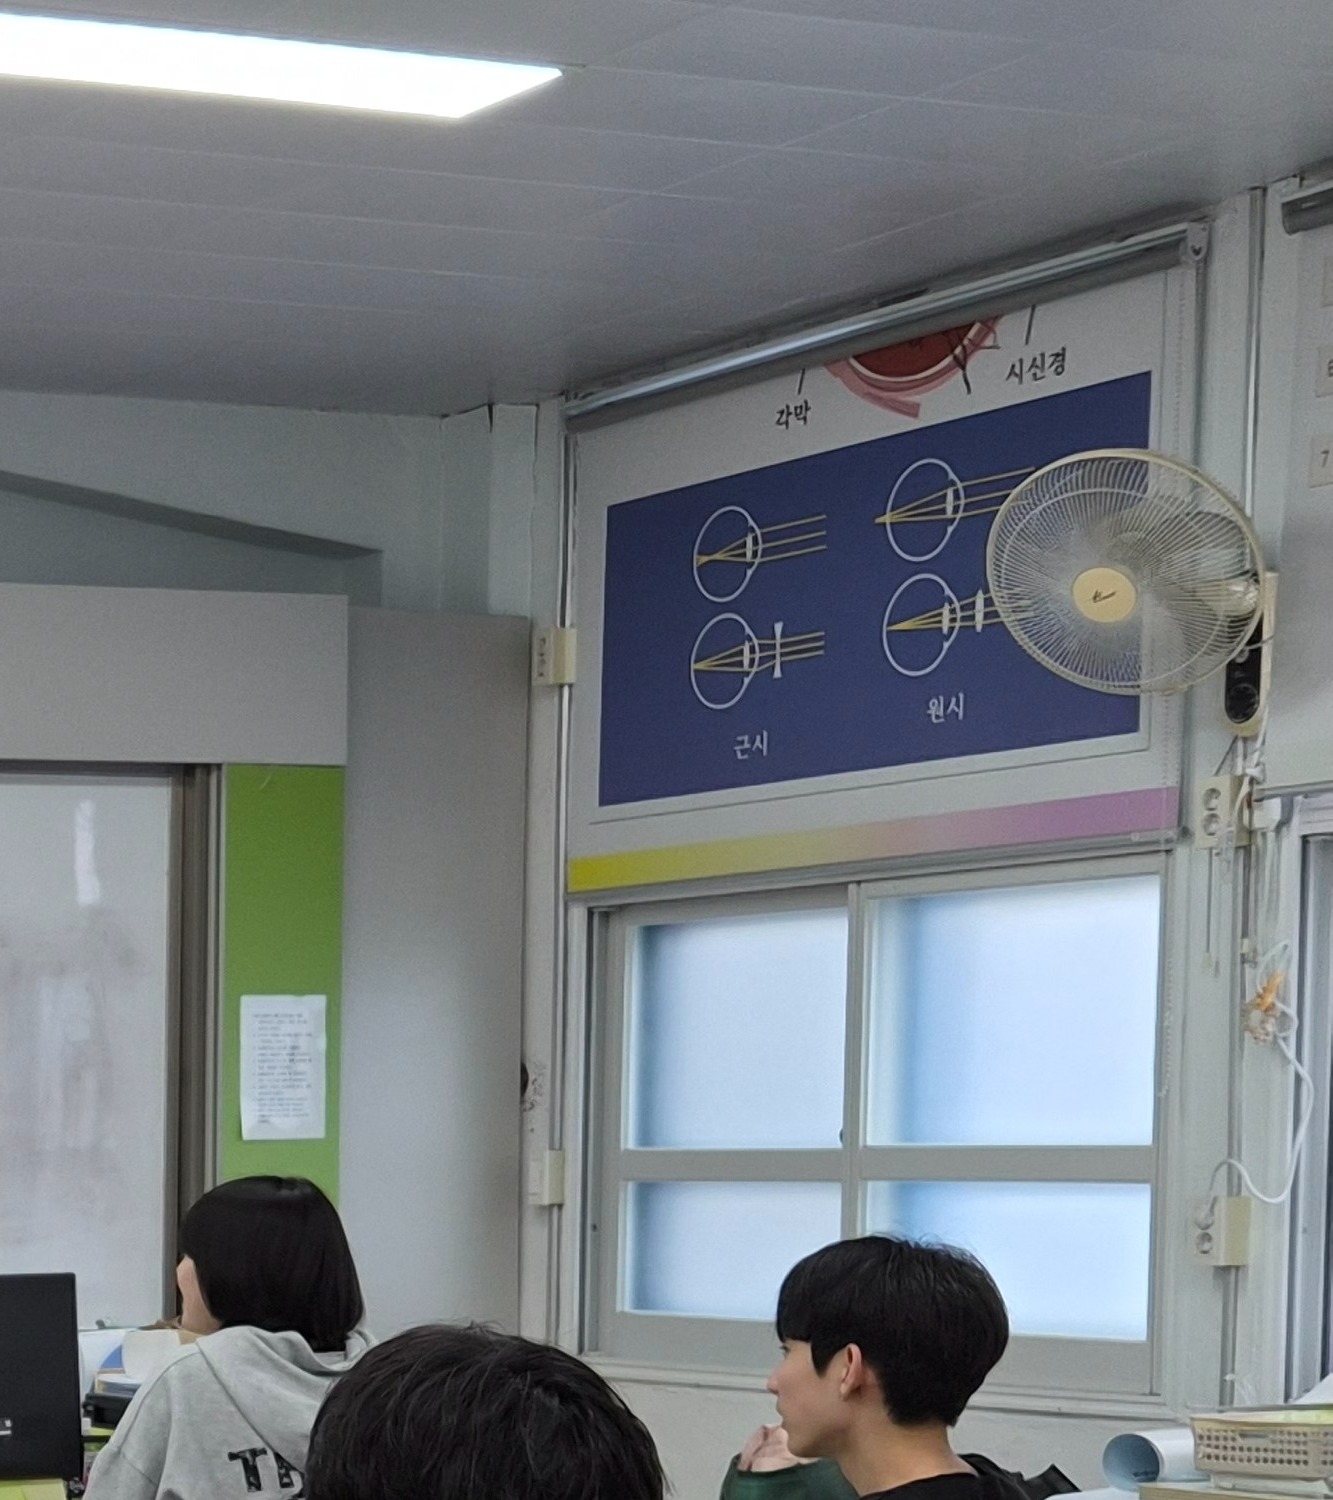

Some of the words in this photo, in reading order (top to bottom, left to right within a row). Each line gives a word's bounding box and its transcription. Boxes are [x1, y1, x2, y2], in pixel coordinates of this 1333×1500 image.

[1005, 346, 1067, 385] 시신경
[775, 399, 812, 430] 각막
[926, 692, 965, 723] 원시
[733, 729, 768, 760] 근시
